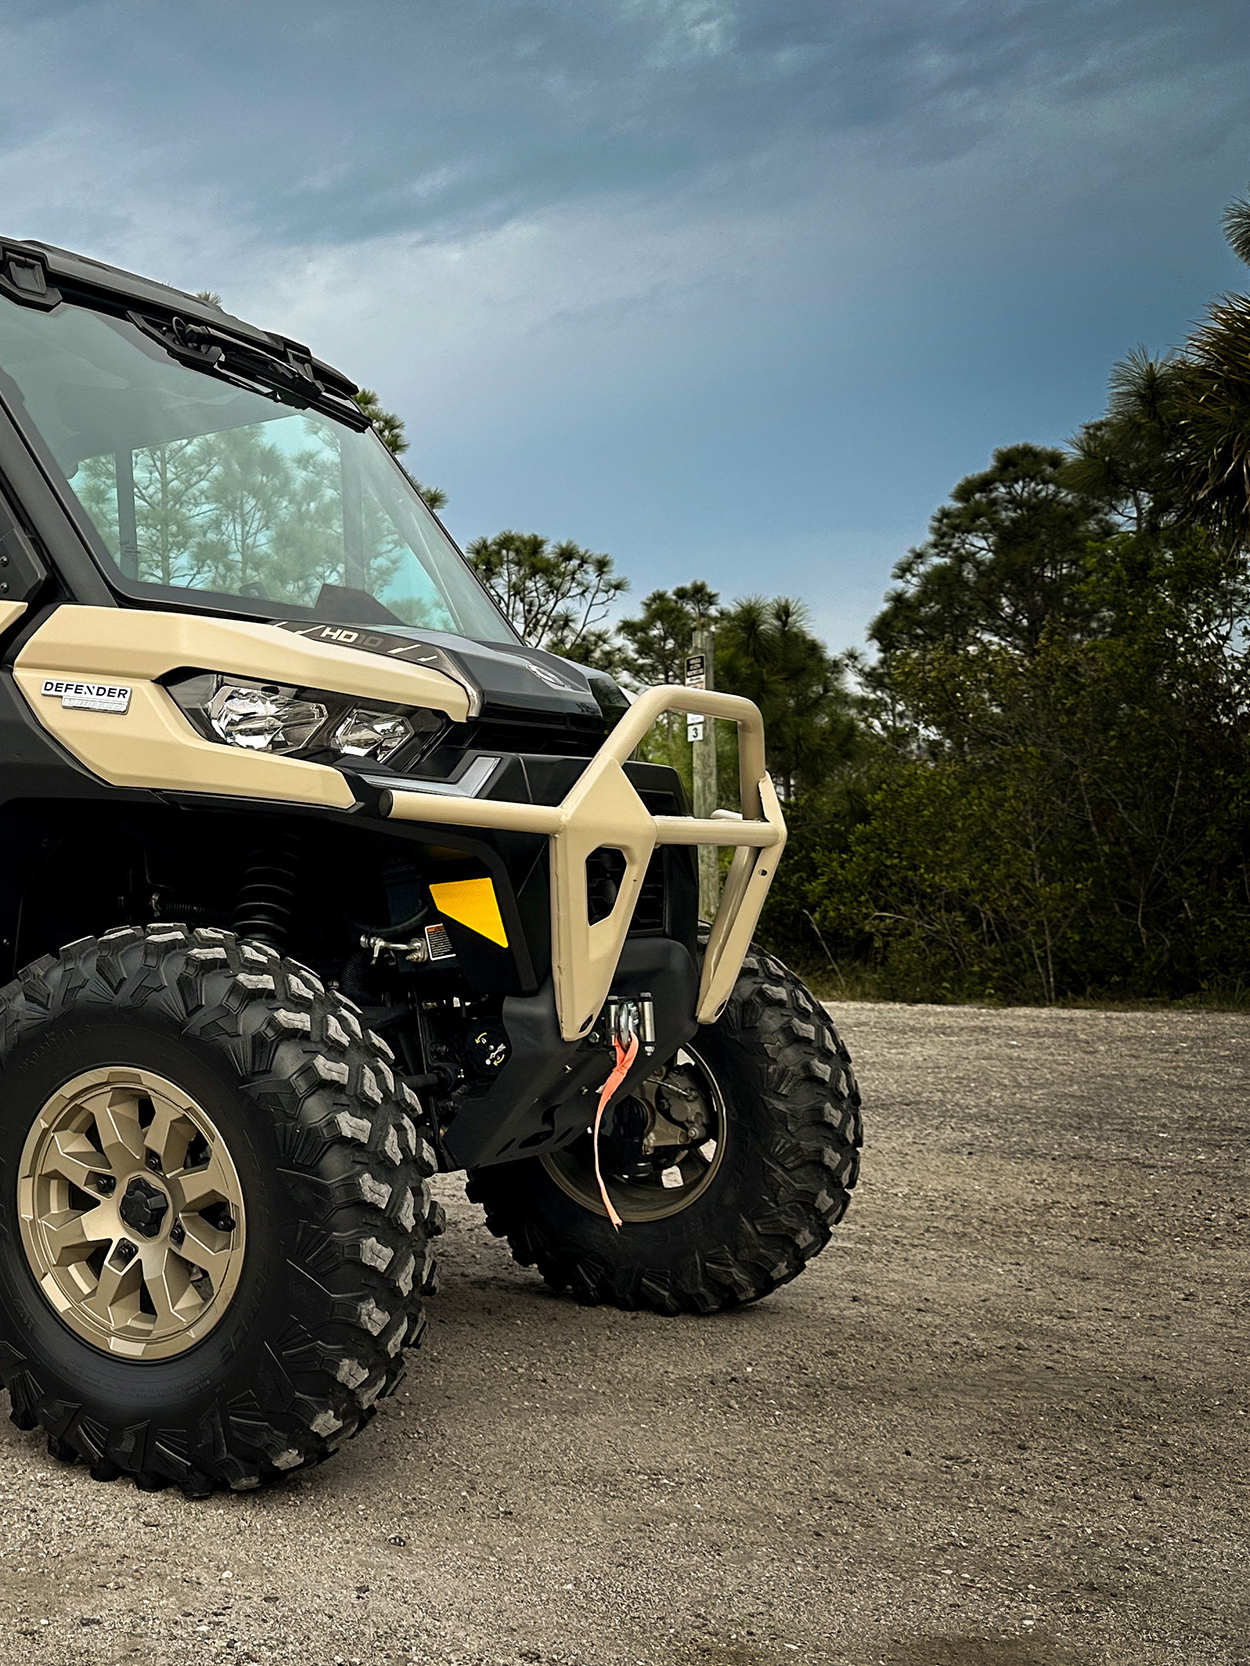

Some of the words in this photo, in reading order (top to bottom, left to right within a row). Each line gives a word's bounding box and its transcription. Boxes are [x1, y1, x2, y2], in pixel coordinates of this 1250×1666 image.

[320, 626, 384, 648] HD10
[43, 681, 129, 699] DEFENDER
[692, 727, 699, 739] 3
